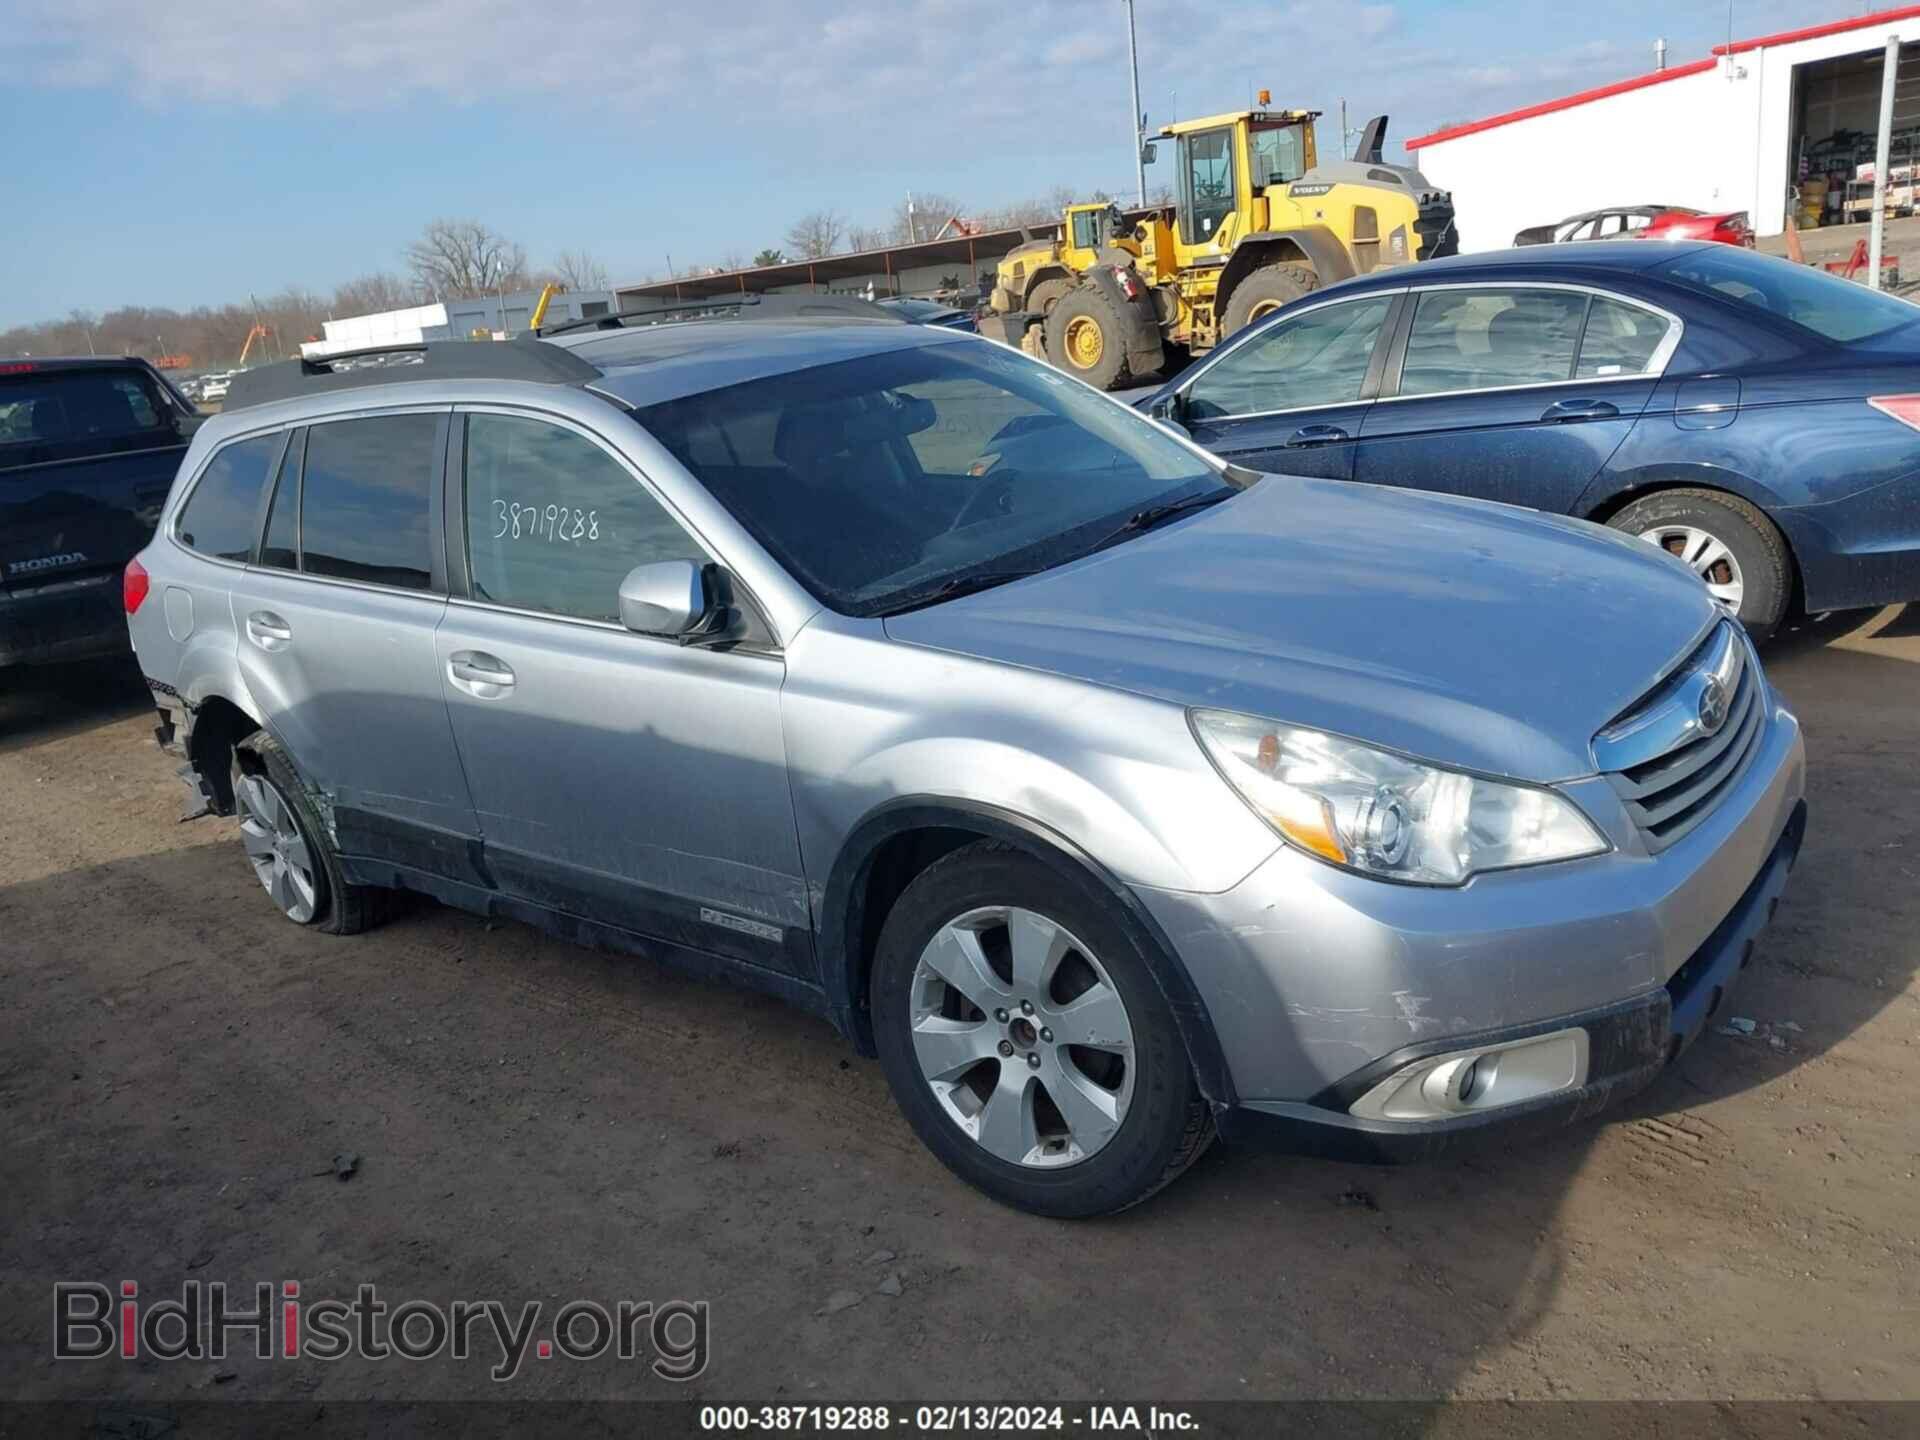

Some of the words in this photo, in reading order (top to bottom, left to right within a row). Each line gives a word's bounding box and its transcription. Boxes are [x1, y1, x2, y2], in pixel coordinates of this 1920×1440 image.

[1294, 186, 1329, 194] VOLVO
[492, 499, 599, 542] 38719288
[8, 552, 88, 574] HONDA
